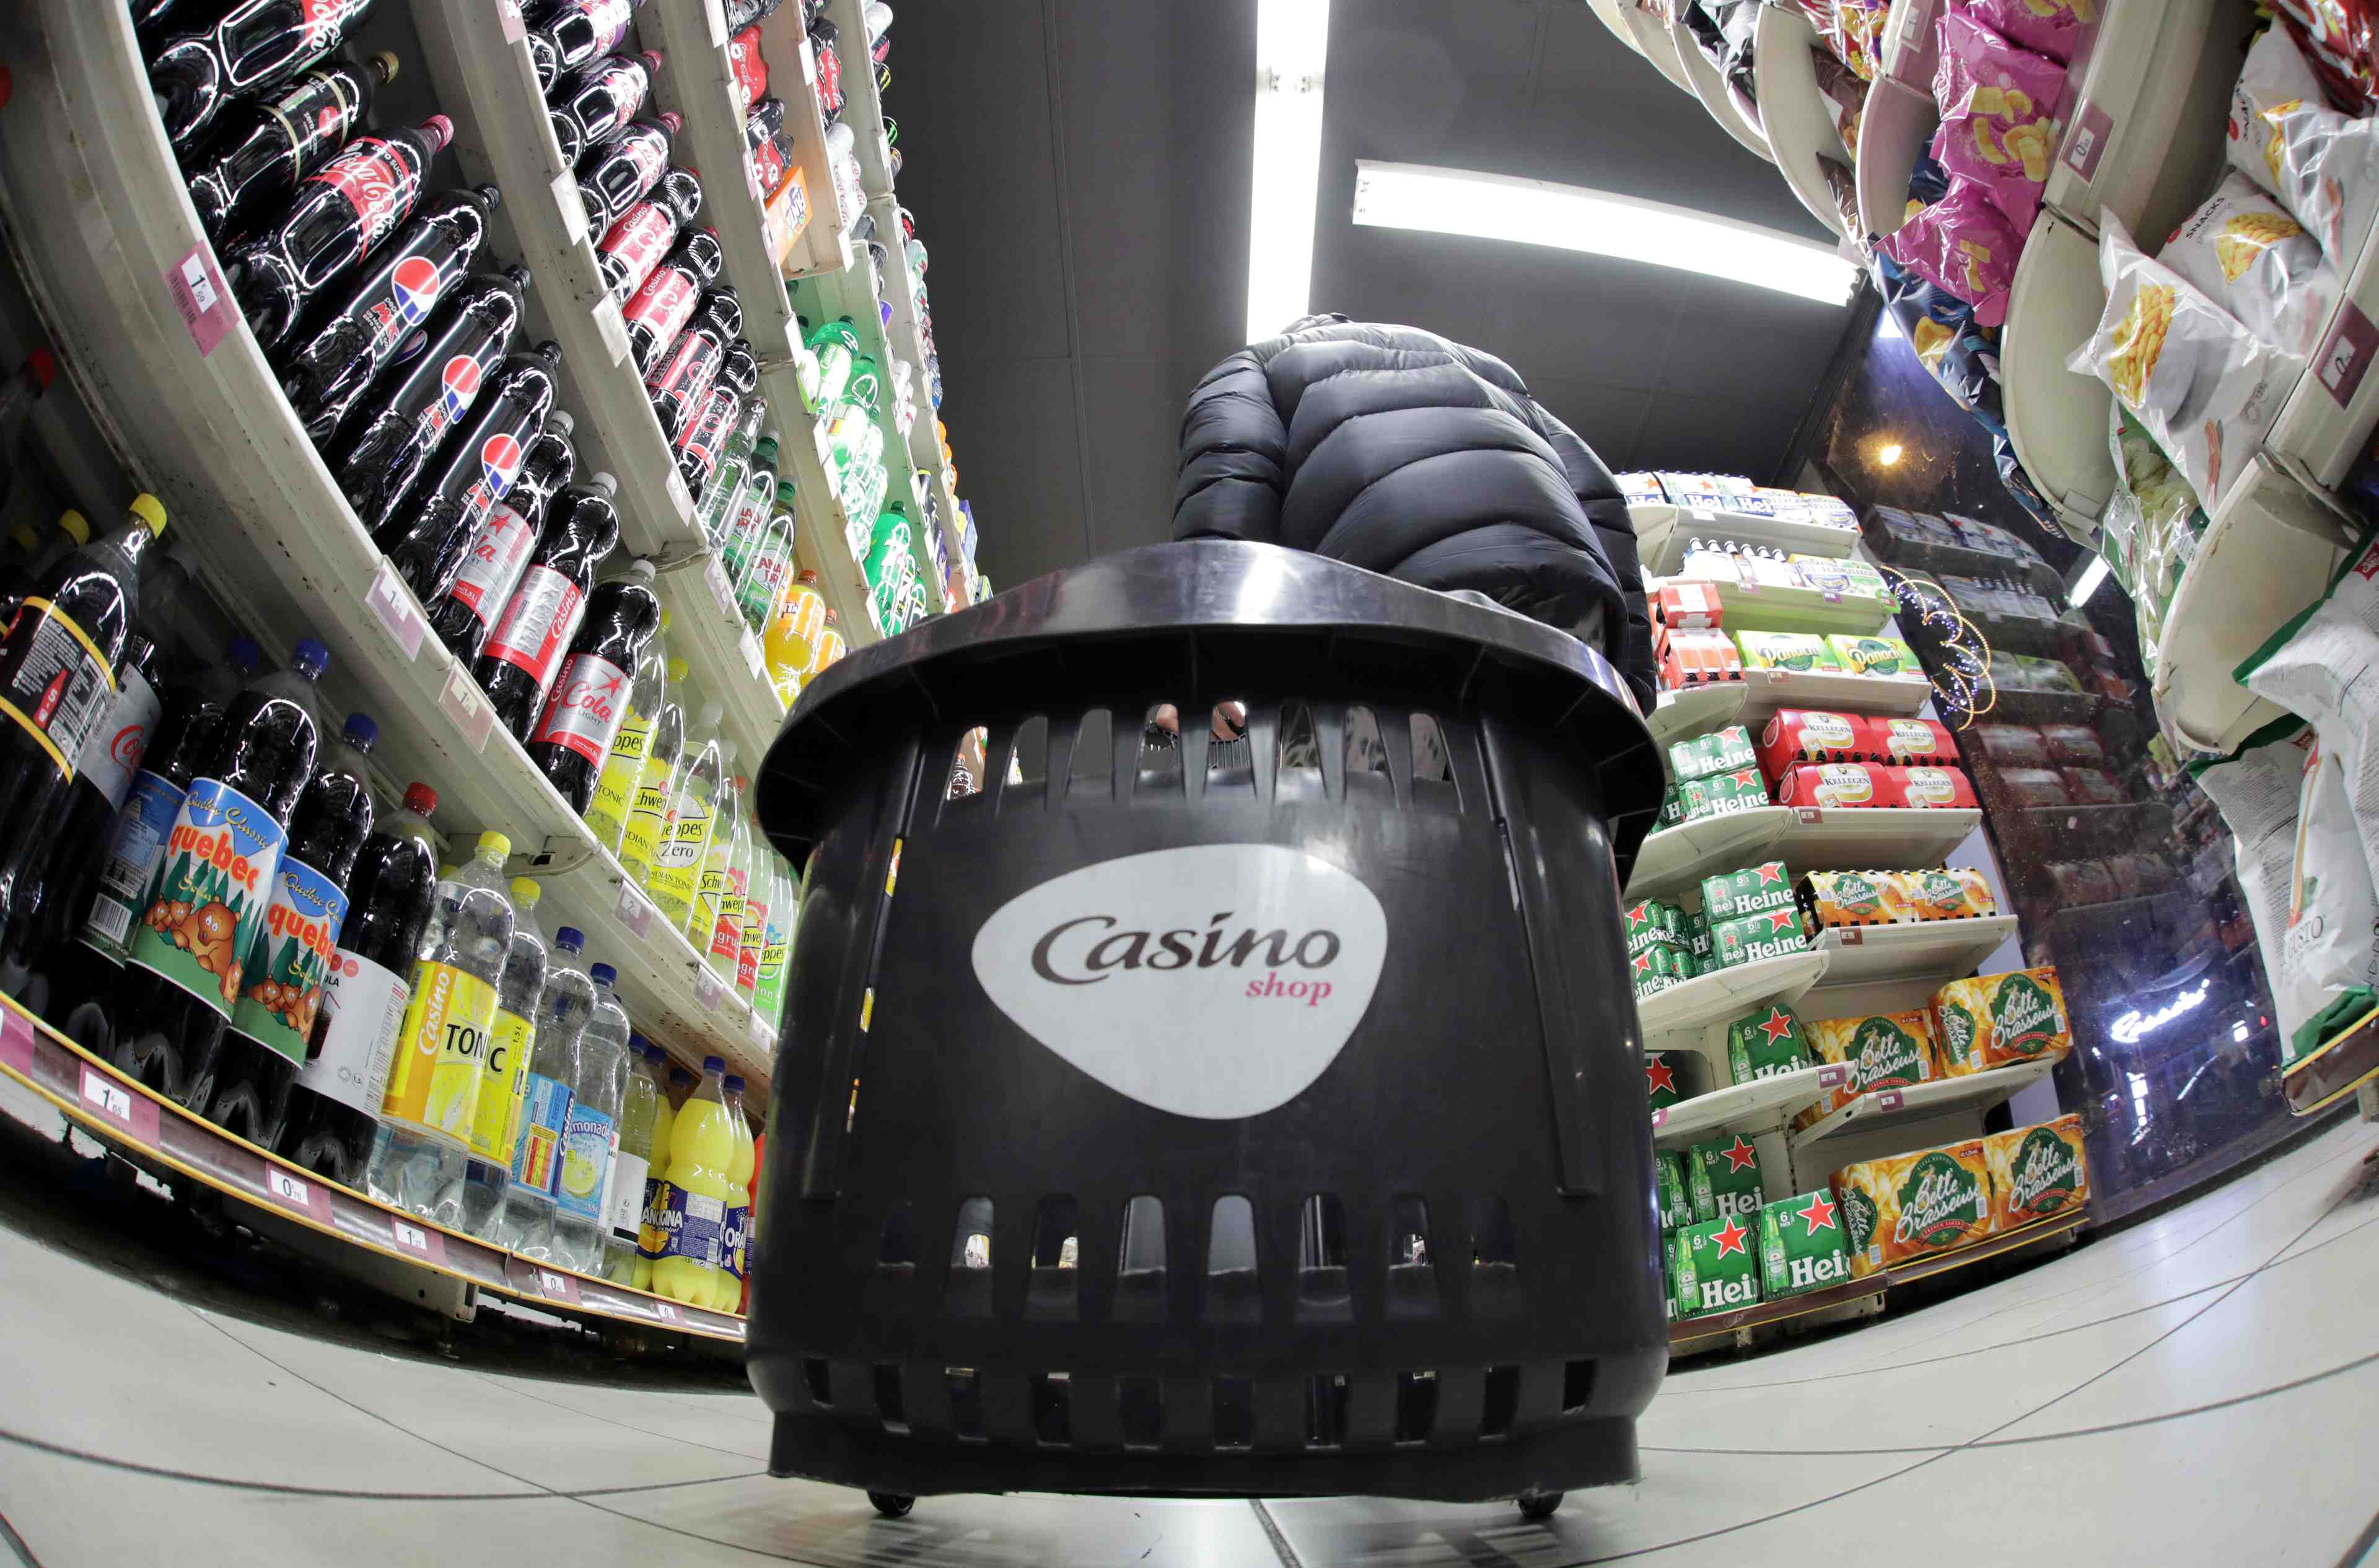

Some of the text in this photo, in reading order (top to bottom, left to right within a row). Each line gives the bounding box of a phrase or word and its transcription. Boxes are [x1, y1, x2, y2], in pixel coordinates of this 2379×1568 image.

[623, 206, 647, 232] Casino
[2186, 197, 2225, 239] SNACKS
[642, 269, 665, 296] Casino
[551, 590, 576, 639] Casino
[550, 658, 573, 703] Casino
[561, 681, 614, 724] Cola
[577, 709, 602, 727] LIGHT
[1808, 723, 1852, 735] KELLEGEN
[597, 784, 624, 807] TONIC
[1824, 776, 1871, 786] KELLEGEN
[661, 844, 694, 859] Zero
[1031, 911, 1341, 985] Casino
[1245, 972, 1333, 1006] shop
[2005, 988, 2039, 1026] Belle
[418, 972, 450, 1056] Casino
[1991, 1002, 2056, 1049] Brasseuse
[1844, 1046, 1922, 1095] Brasseuse
[1860, 1031, 1901, 1070] Belle
[559, 1097, 574, 1157] Casino
[2008, 1154, 2078, 1212] Brasseuse
[2024, 1141, 2060, 1185] Belle
[1914, 1168, 1958, 1214] Belle
[1894, 1182, 1981, 1244] Brasseuse
